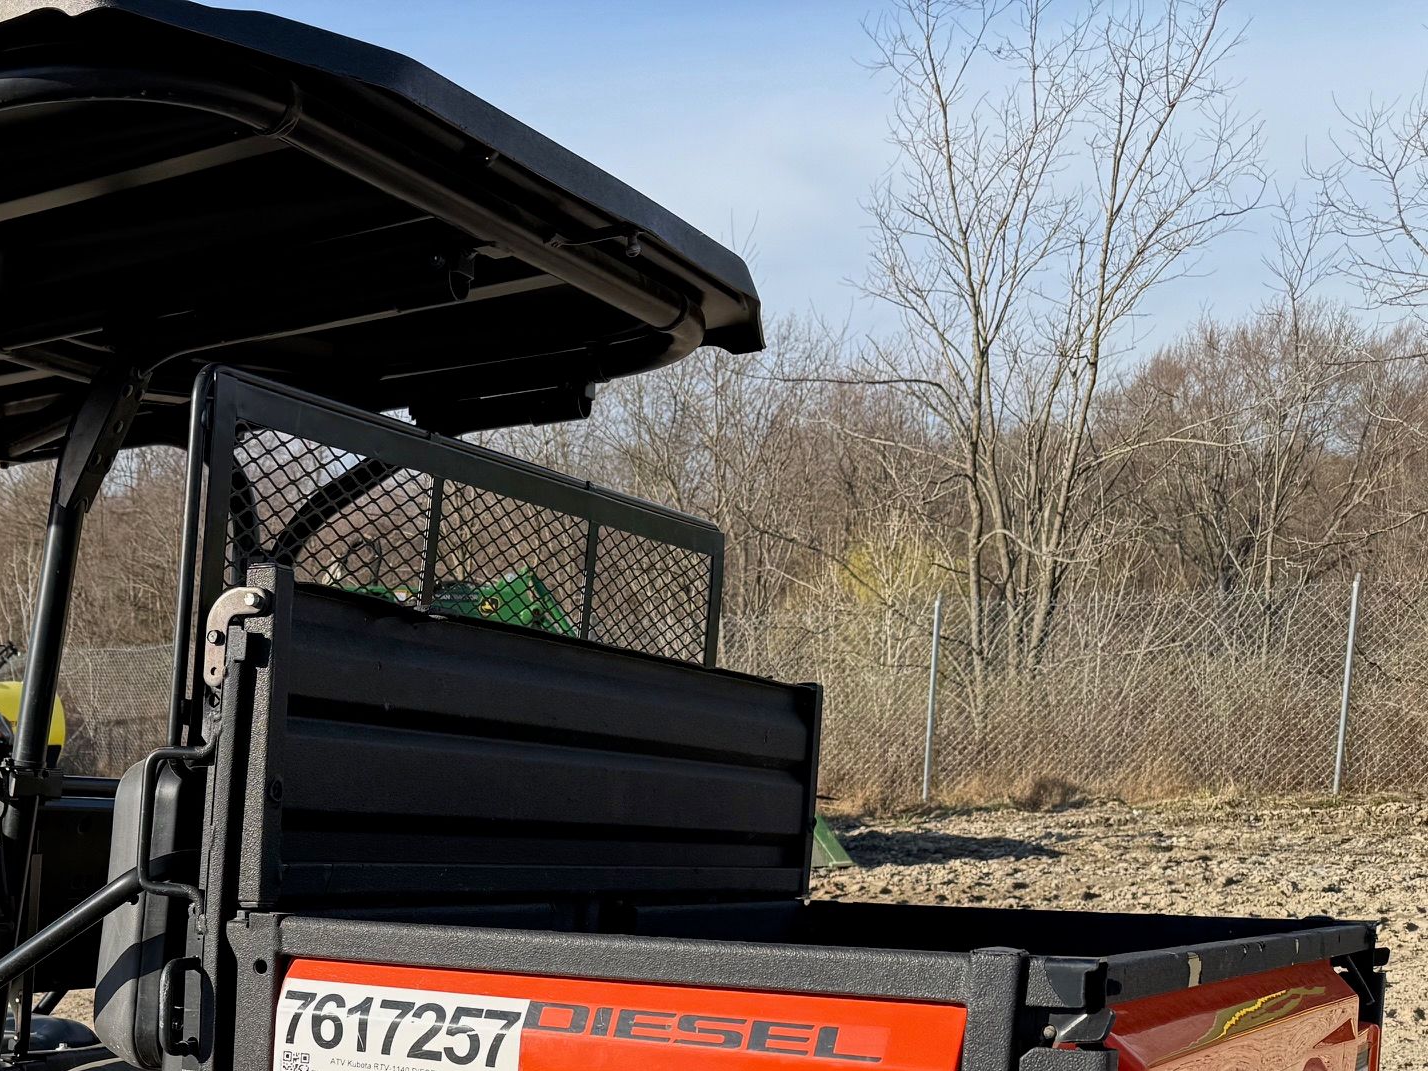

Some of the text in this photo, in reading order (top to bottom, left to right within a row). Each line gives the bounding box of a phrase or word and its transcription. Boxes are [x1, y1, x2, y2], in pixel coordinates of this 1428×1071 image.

[285, 990, 522, 1068] 7617257
[523, 1000, 882, 1062] DIESEL
[330, 1057, 346, 1067] ATV
[347, 1060, 372, 1070] Kubota
